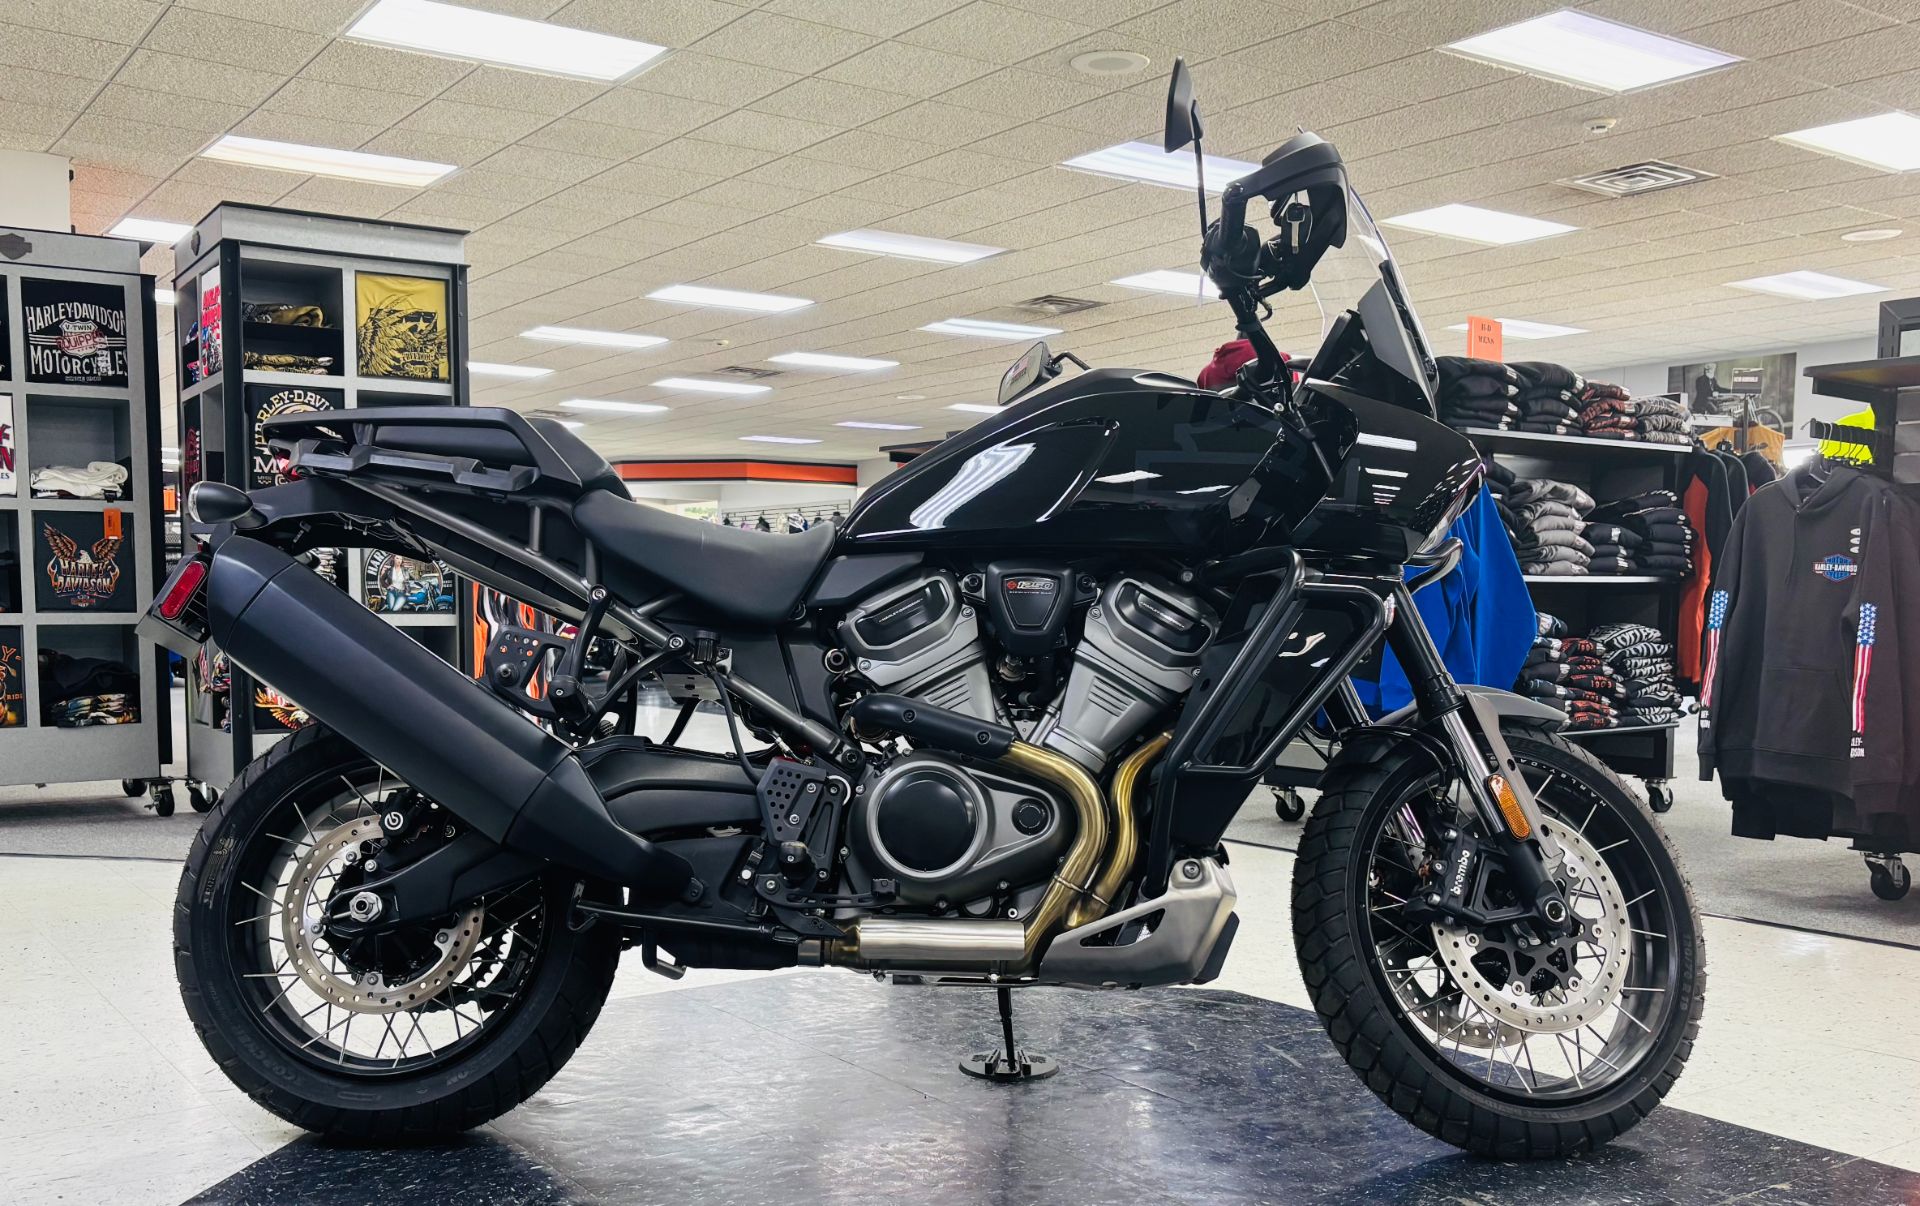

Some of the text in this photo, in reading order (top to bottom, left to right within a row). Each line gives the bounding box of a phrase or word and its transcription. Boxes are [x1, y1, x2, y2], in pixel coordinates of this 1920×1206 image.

[30, 345, 128, 376] MOTORCYLE
[1814, 563, 1858, 573] HARLEY-DAVIDSO
[1450, 849, 1471, 896] brembo
